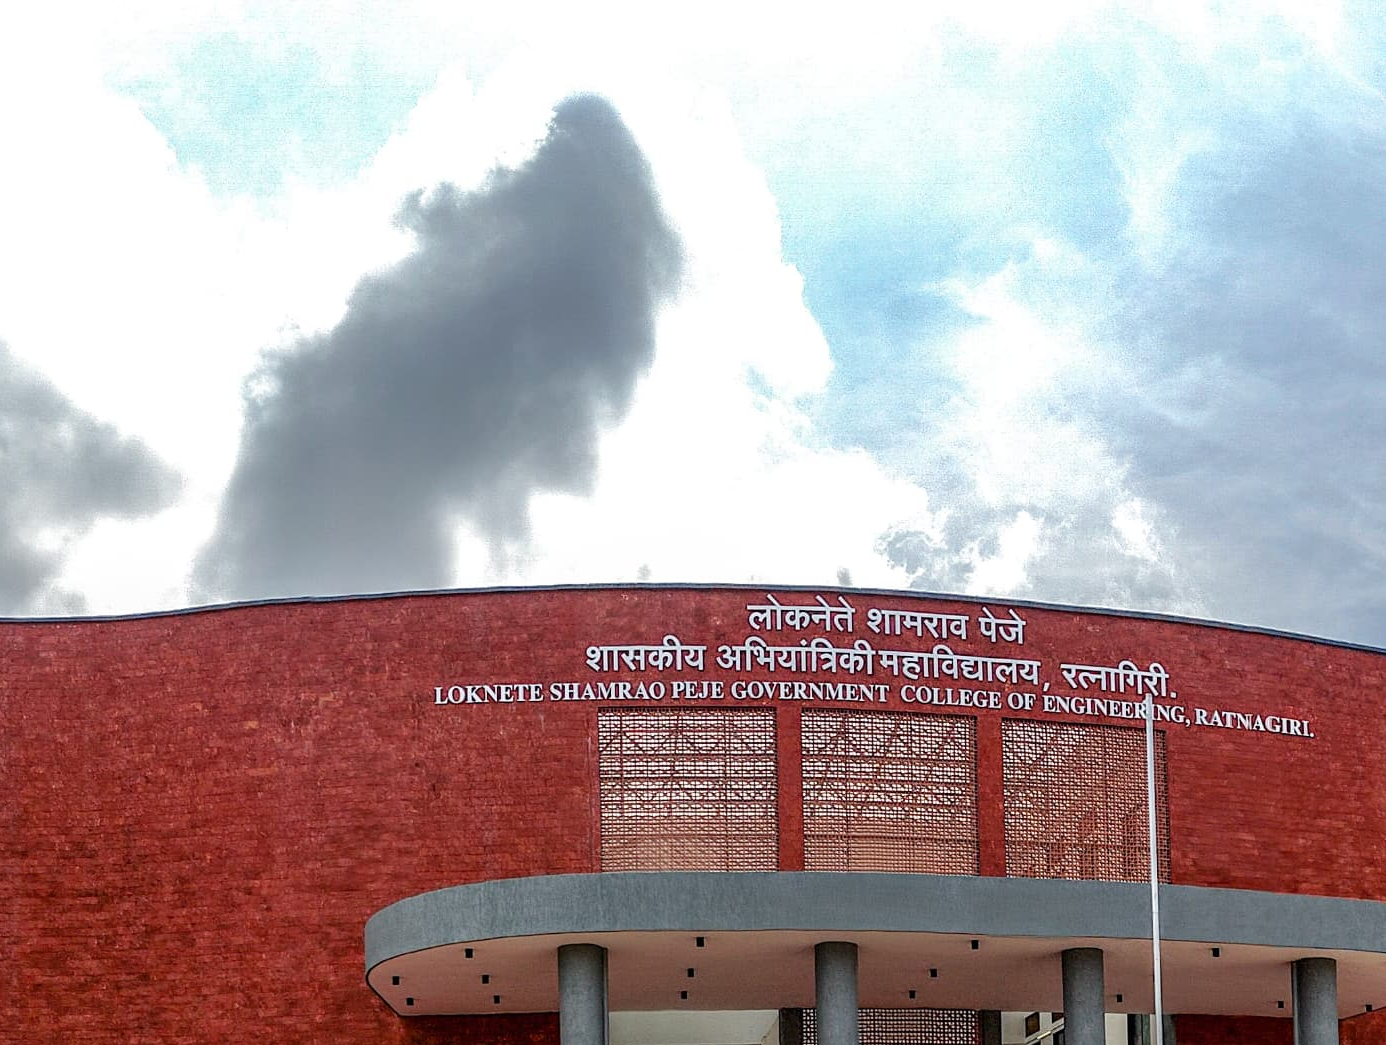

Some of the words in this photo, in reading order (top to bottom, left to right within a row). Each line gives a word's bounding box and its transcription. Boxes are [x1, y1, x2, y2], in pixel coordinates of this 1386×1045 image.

[746, 594, 855, 633] लोकनेते
[866, 608, 968, 640] शामराव
[978, 606, 1026, 645] पेजे
[585, 634, 707, 672] शासकीय
[716, 635, 876, 676] अभियांत्रिकी
[879, 644, 1051, 690] महाविद्यालय,
[1059, 659, 1178, 699] रत्नागिरी.
[434, 683, 544, 705] LOKNETE
[549, 681, 666, 701] SHAMRAO
[670, 681, 725, 700] PEJE
[730, 682, 890, 703] GOVERNMENT
[900, 685, 1002, 709] COLLEGE
[1007, 692, 1036, 712] OF
[1042, 695, 1192, 727] ENGINEERING,
[1195, 708, 1315, 739] RATNAGIRI.
